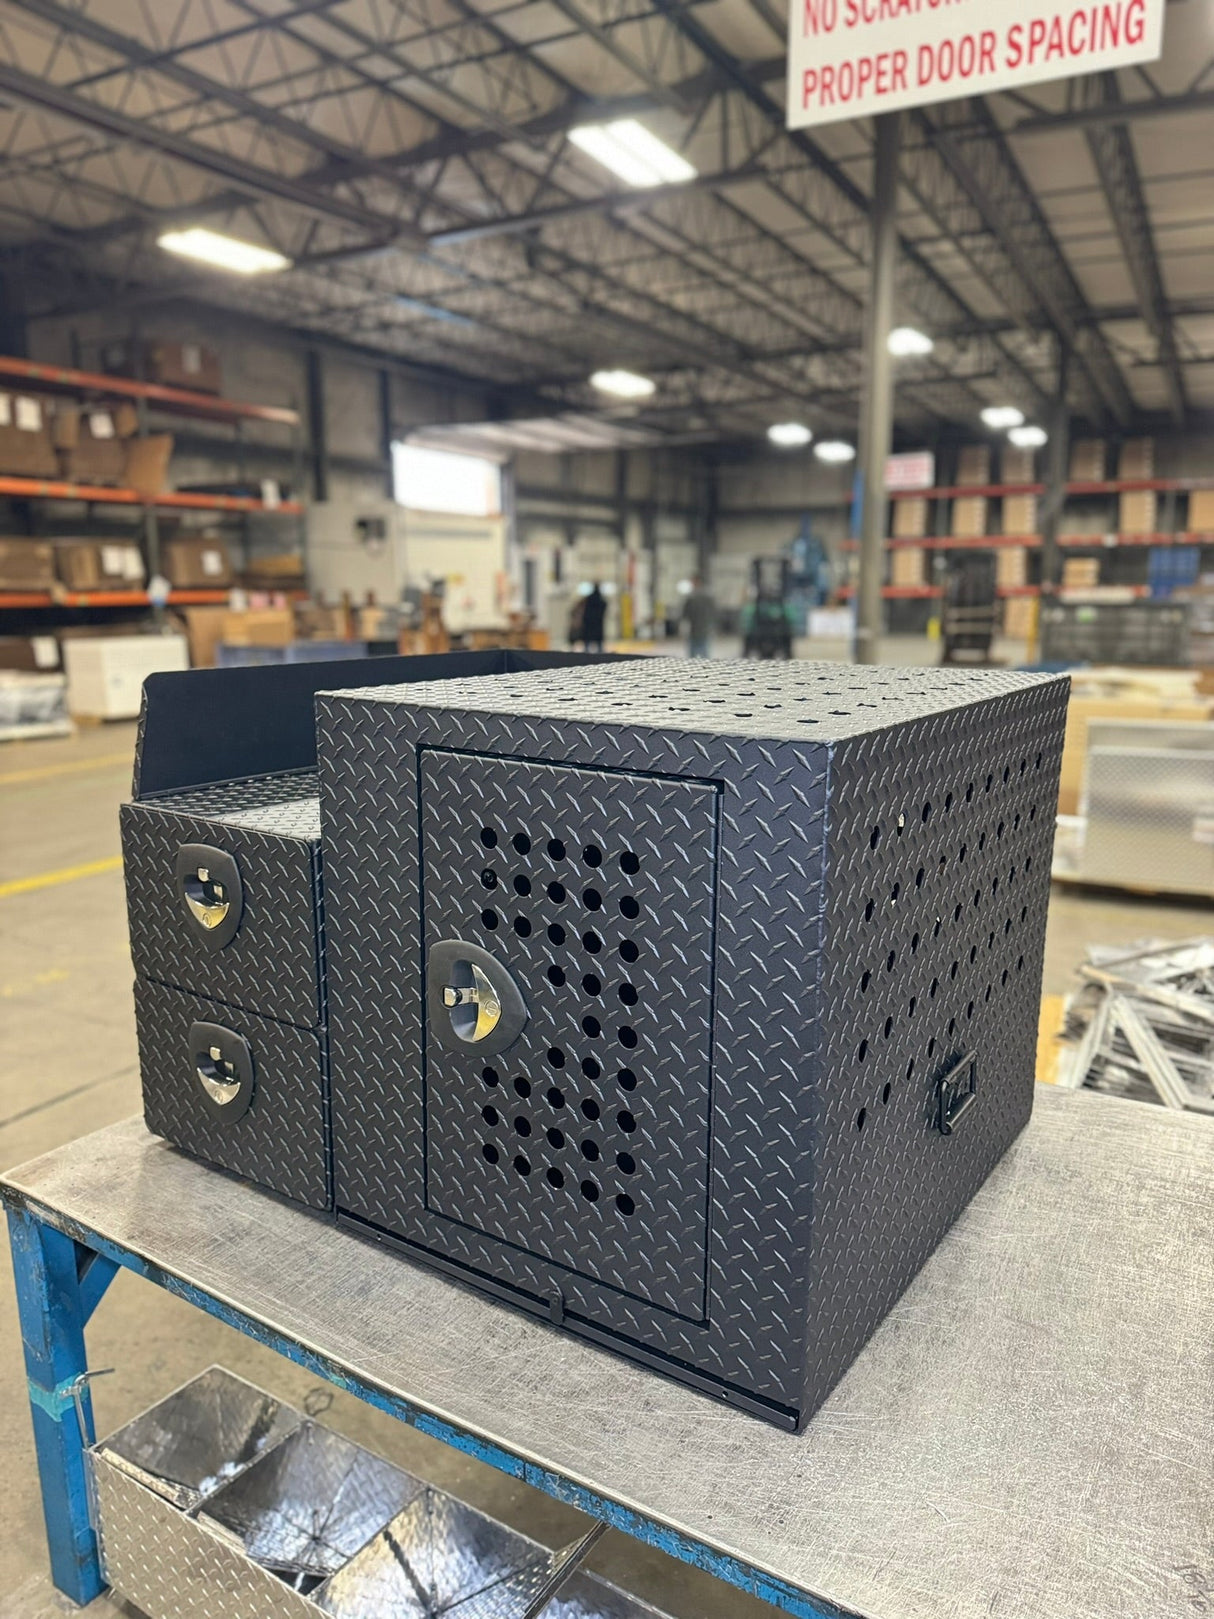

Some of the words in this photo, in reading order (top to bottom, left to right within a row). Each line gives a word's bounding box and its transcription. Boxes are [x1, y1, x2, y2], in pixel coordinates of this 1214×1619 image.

[801, 48, 909, 110] PROPER
[916, 30, 998, 88] DOOR
[1005, 0, 1146, 70] SPACING
[802, 0, 840, 38] NO
